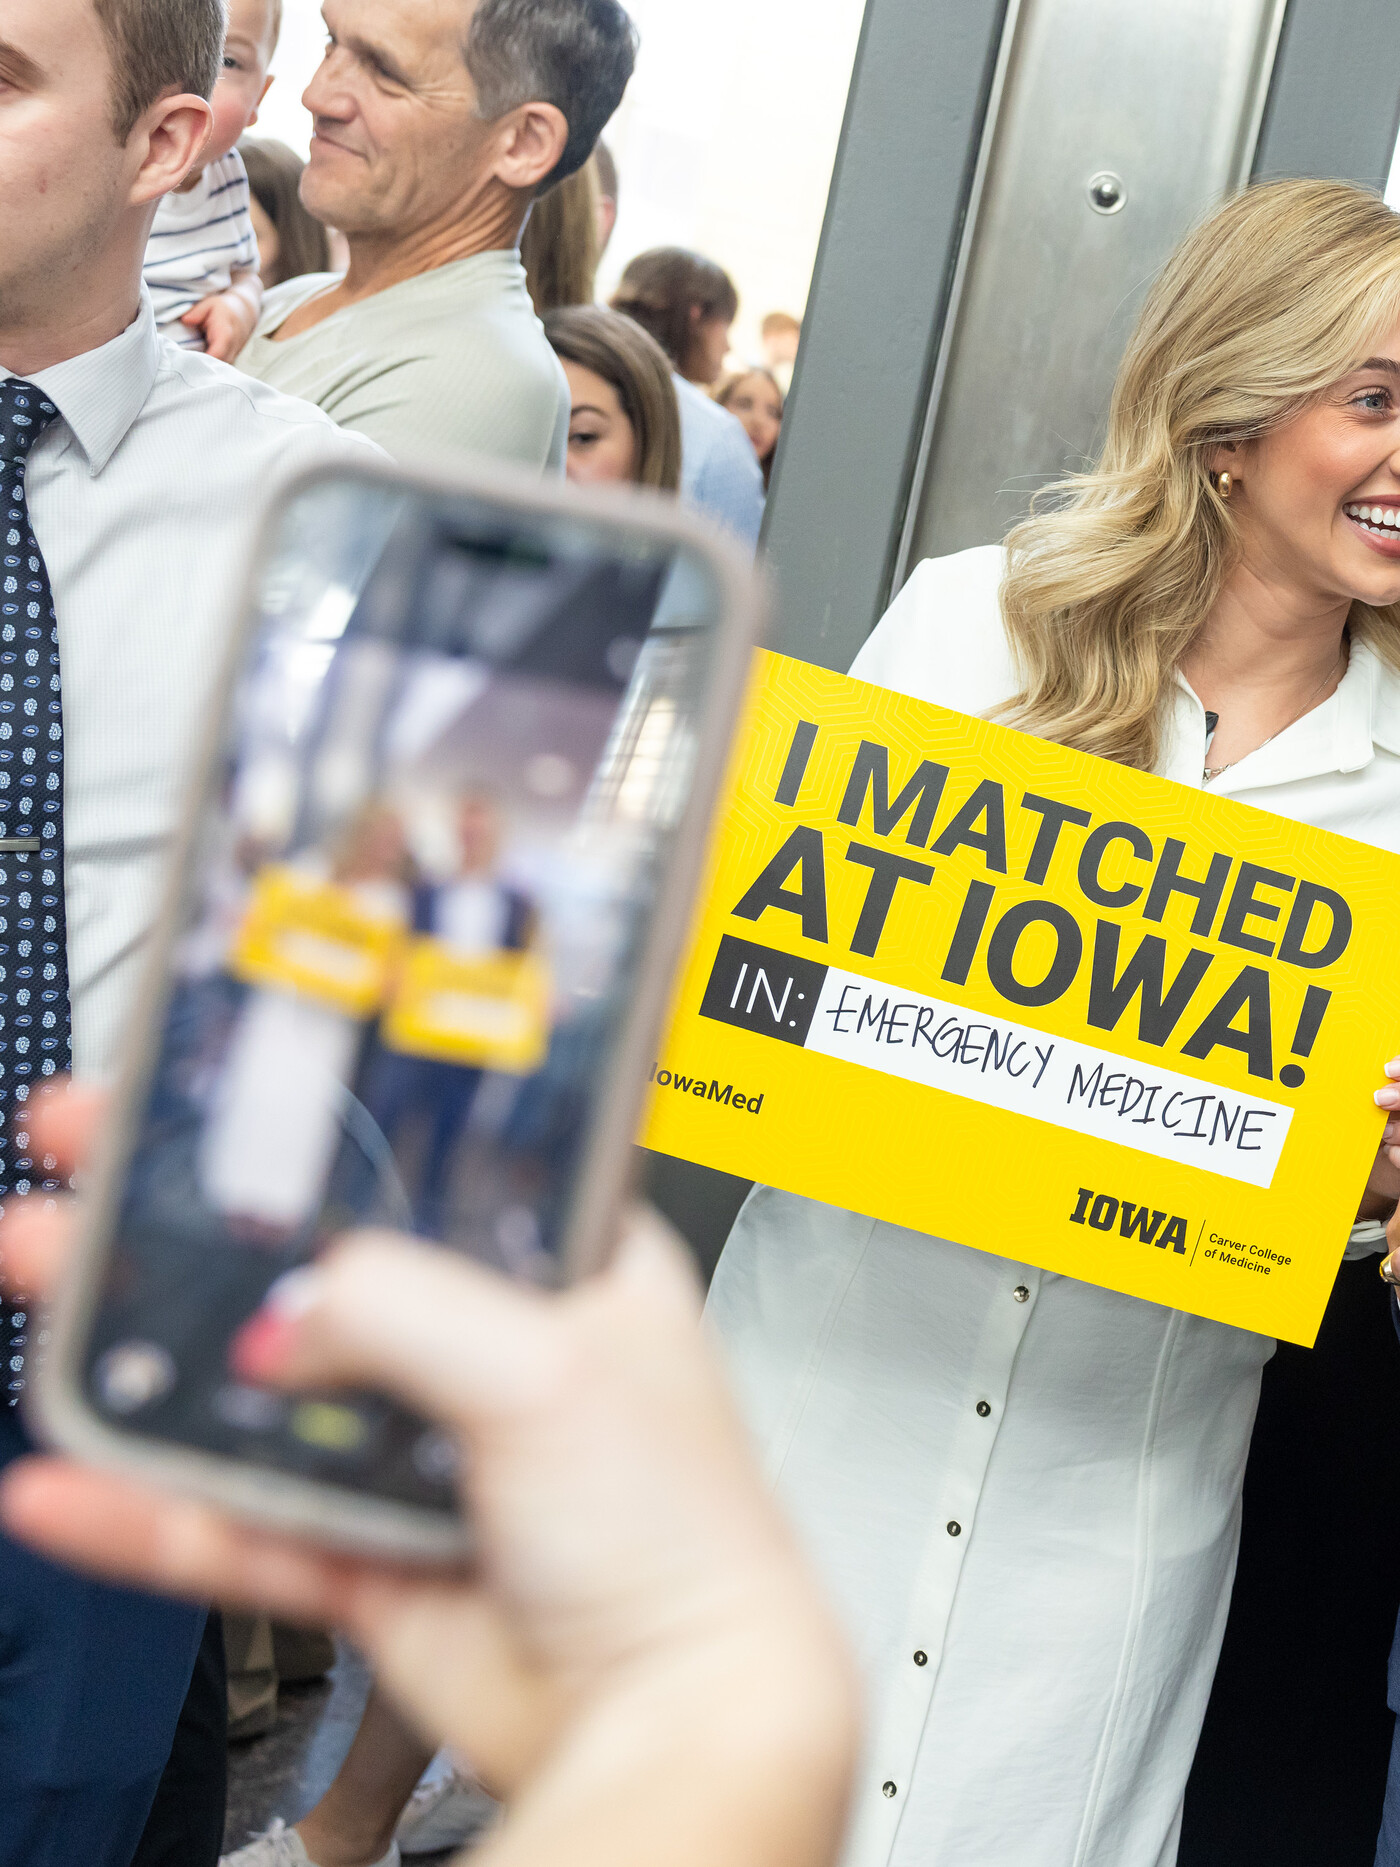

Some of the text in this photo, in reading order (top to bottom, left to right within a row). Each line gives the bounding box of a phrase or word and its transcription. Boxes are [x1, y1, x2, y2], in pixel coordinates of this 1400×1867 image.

[775, 721, 1352, 968] I MATCHED
[731, 825, 1333, 1088] AT IOWA!
[729, 962, 805, 1027] IN:
[648, 1061, 765, 1115] IowaMed
[826, 985, 1276, 1151] EMERGENCY MEDICINE
[1069, 1187, 1188, 1256] IOWA
[1209, 1233, 1292, 1266] Carver College
[1204, 1248, 1271, 1275] of Medicine
